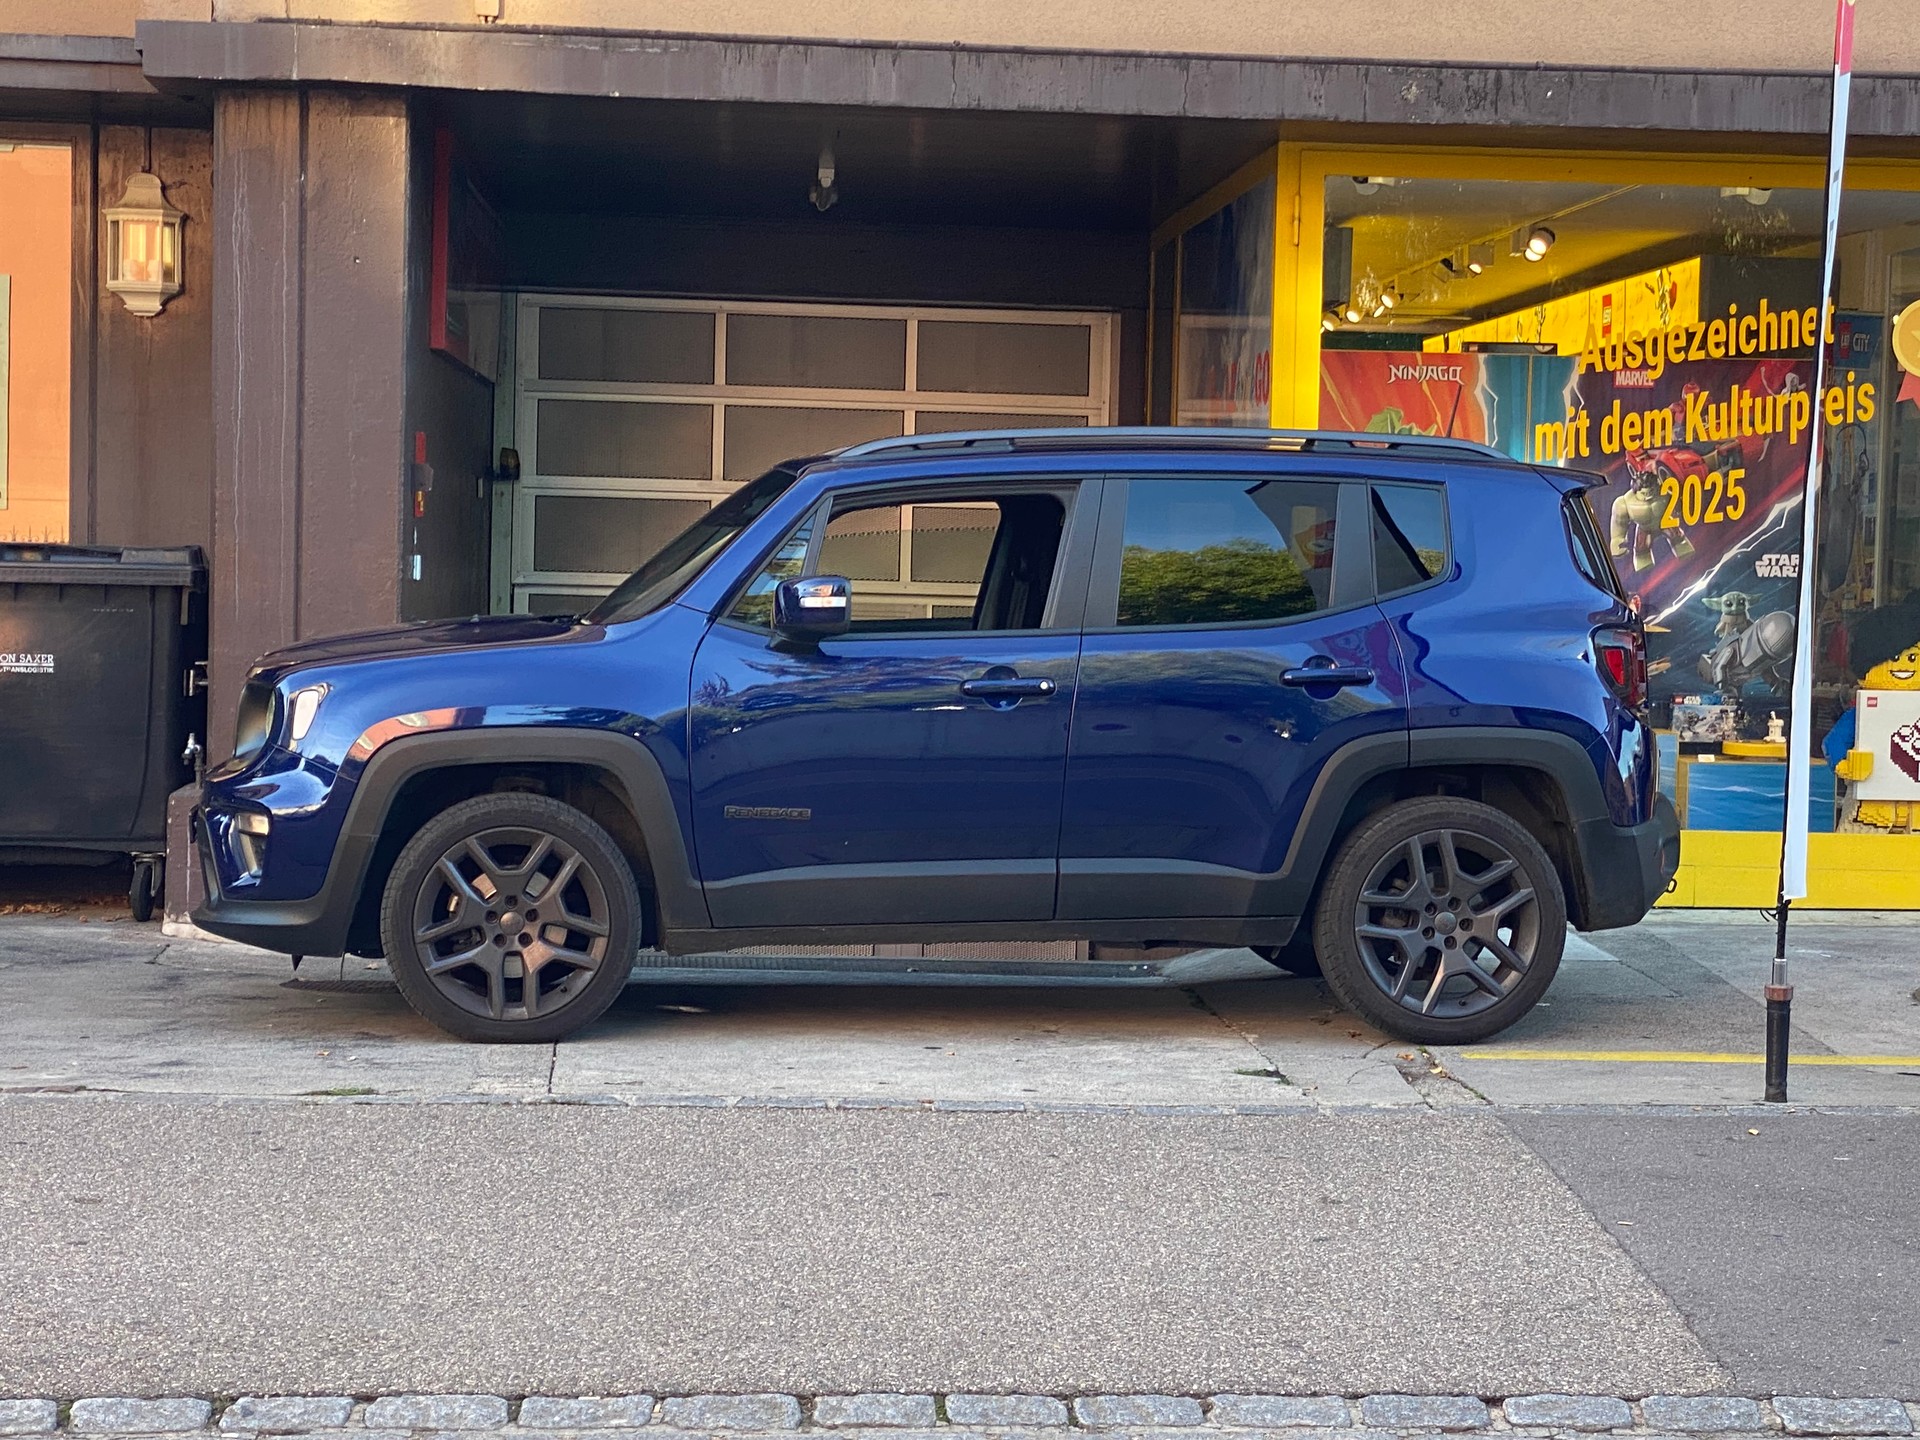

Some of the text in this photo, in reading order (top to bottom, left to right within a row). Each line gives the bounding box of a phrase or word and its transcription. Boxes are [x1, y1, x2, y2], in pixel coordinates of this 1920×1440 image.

[1578, 297, 1835, 380] Ausgezeichnet
[1387, 364, 1465, 386] NINJAGO
[1535, 371, 1876, 462] mit dem Kulturpeis
[1660, 468, 1746, 529] 2025
[19, 653, 54, 664] SAXER
[723, 805, 812, 820] RENEGADE
